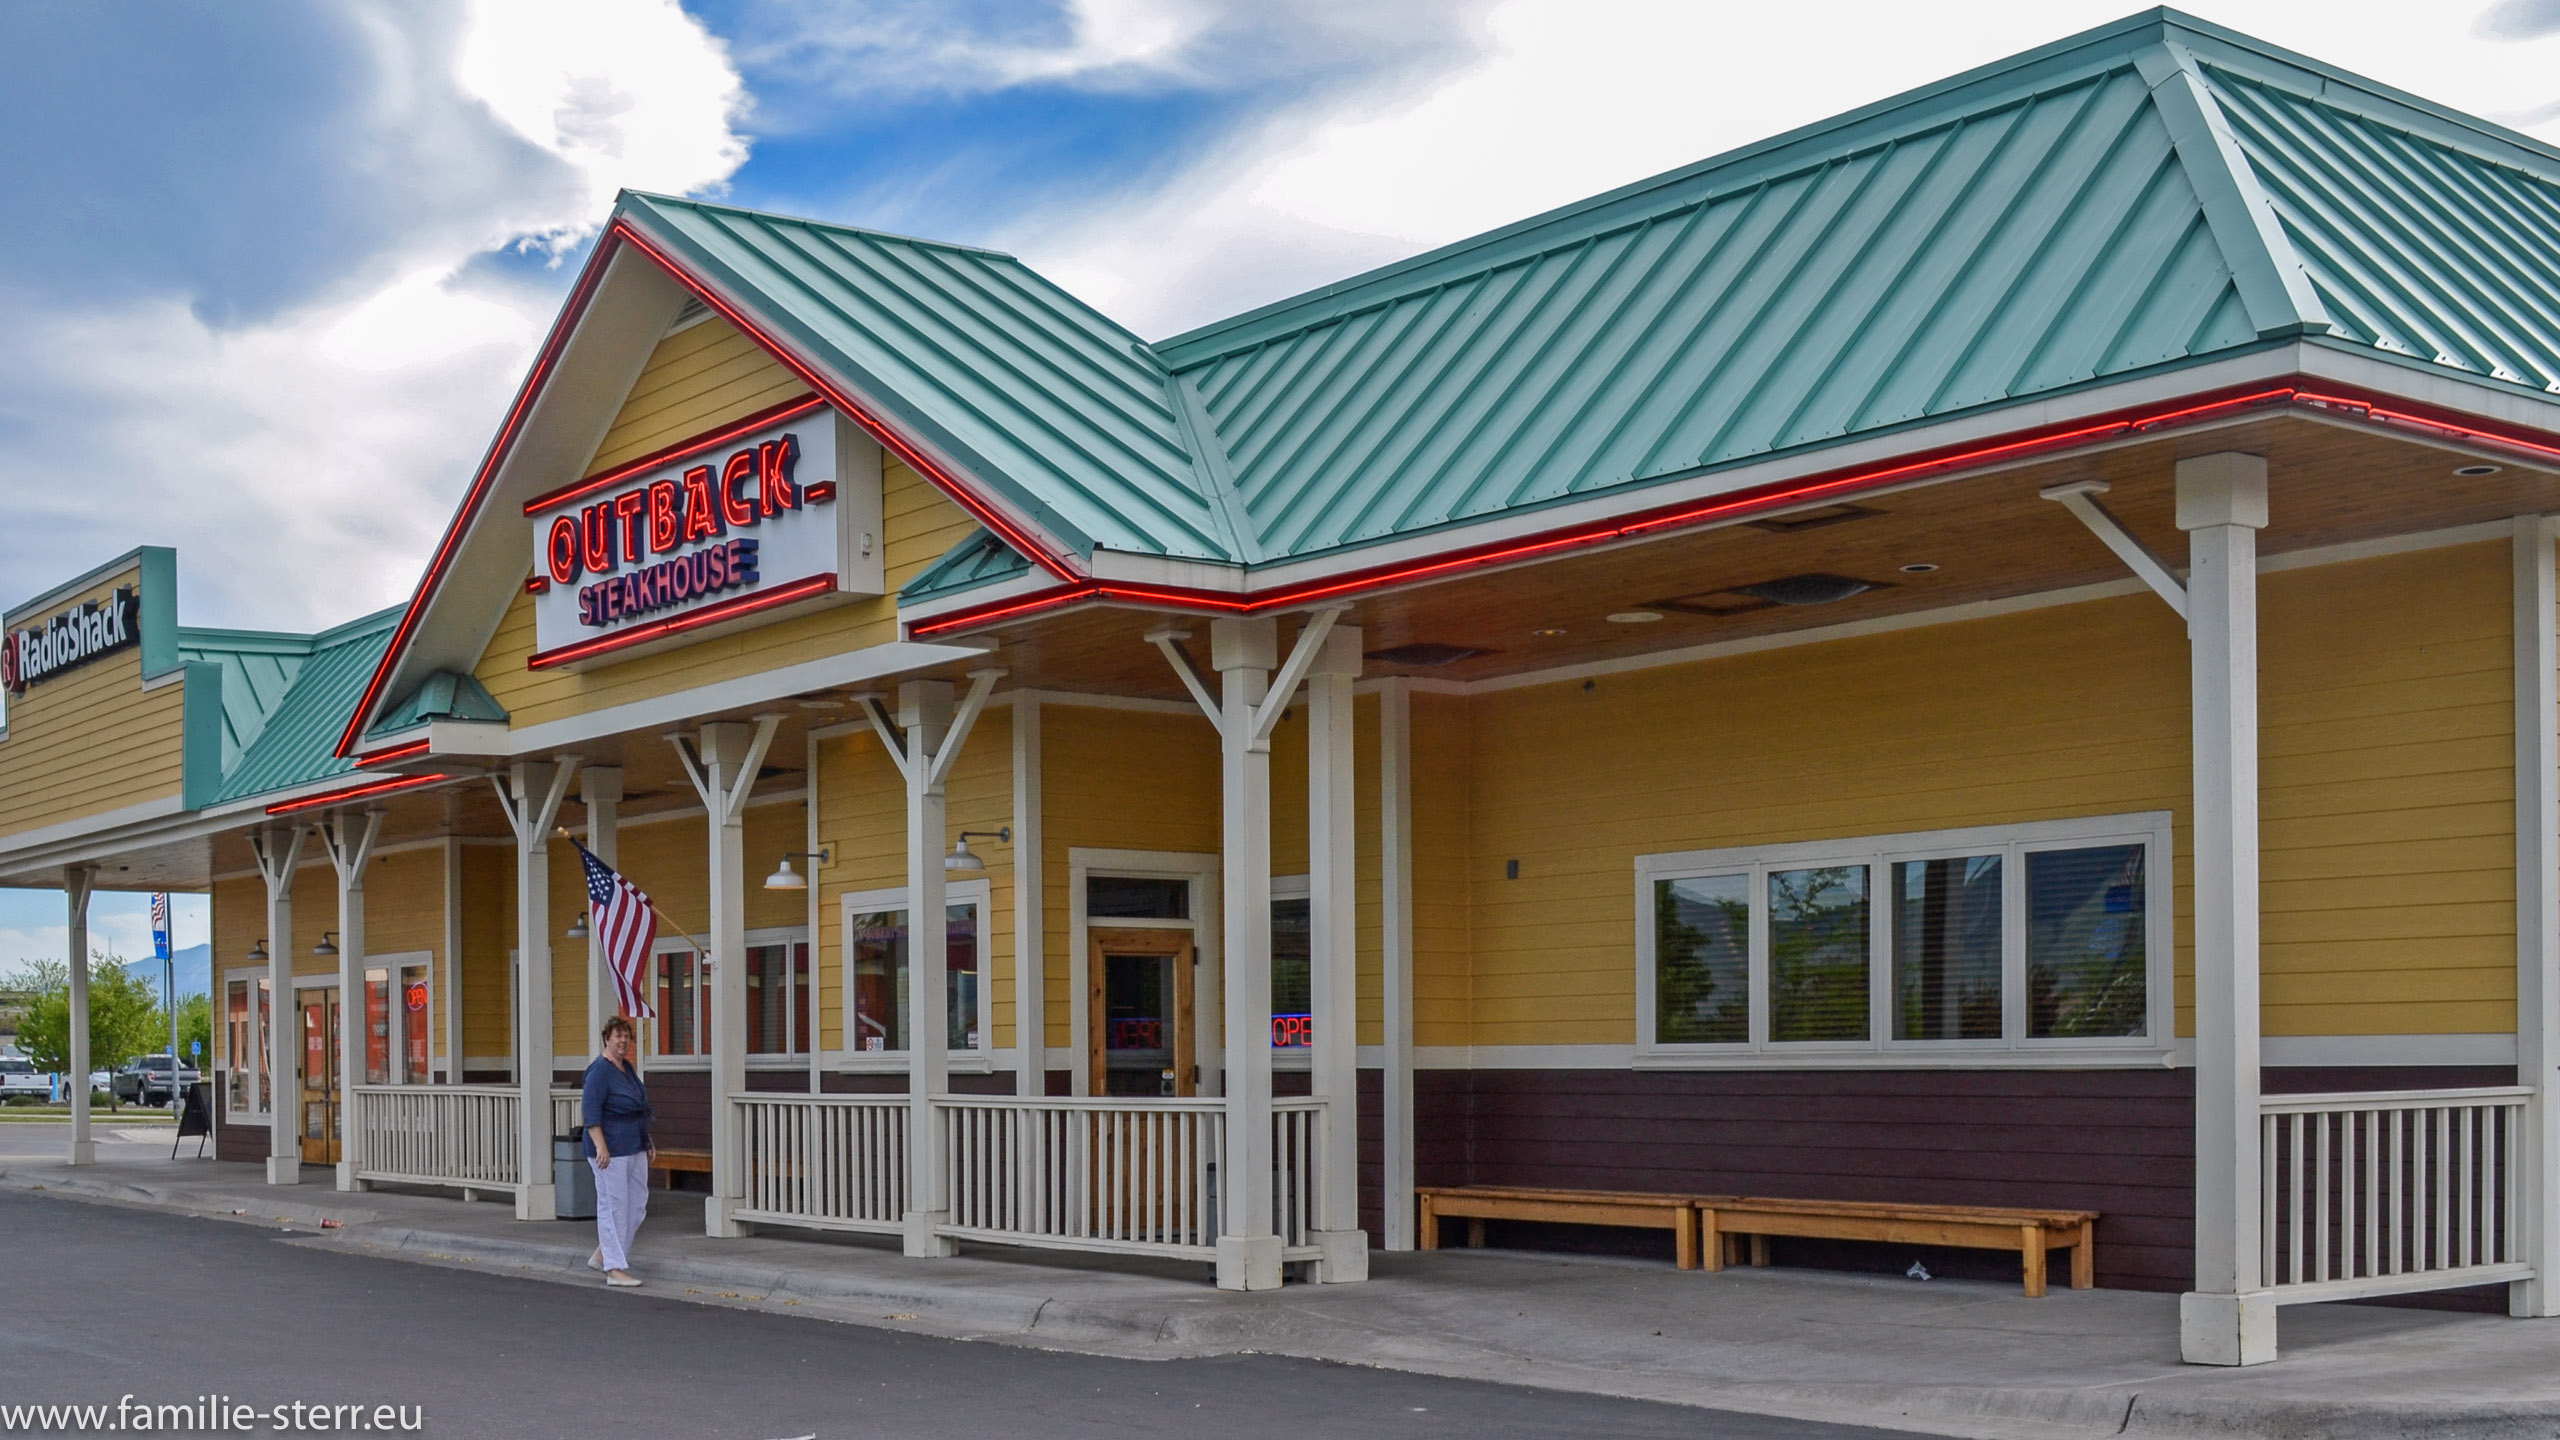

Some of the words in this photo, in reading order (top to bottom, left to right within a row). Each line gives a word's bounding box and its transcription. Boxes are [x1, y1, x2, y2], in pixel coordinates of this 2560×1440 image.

[548, 434, 798, 584] OUTBACK
[579, 538, 755, 626] STEAKHOUSE
[19, 588, 127, 682] RadioShack
[1272, 1017, 1312, 1046] OPE
